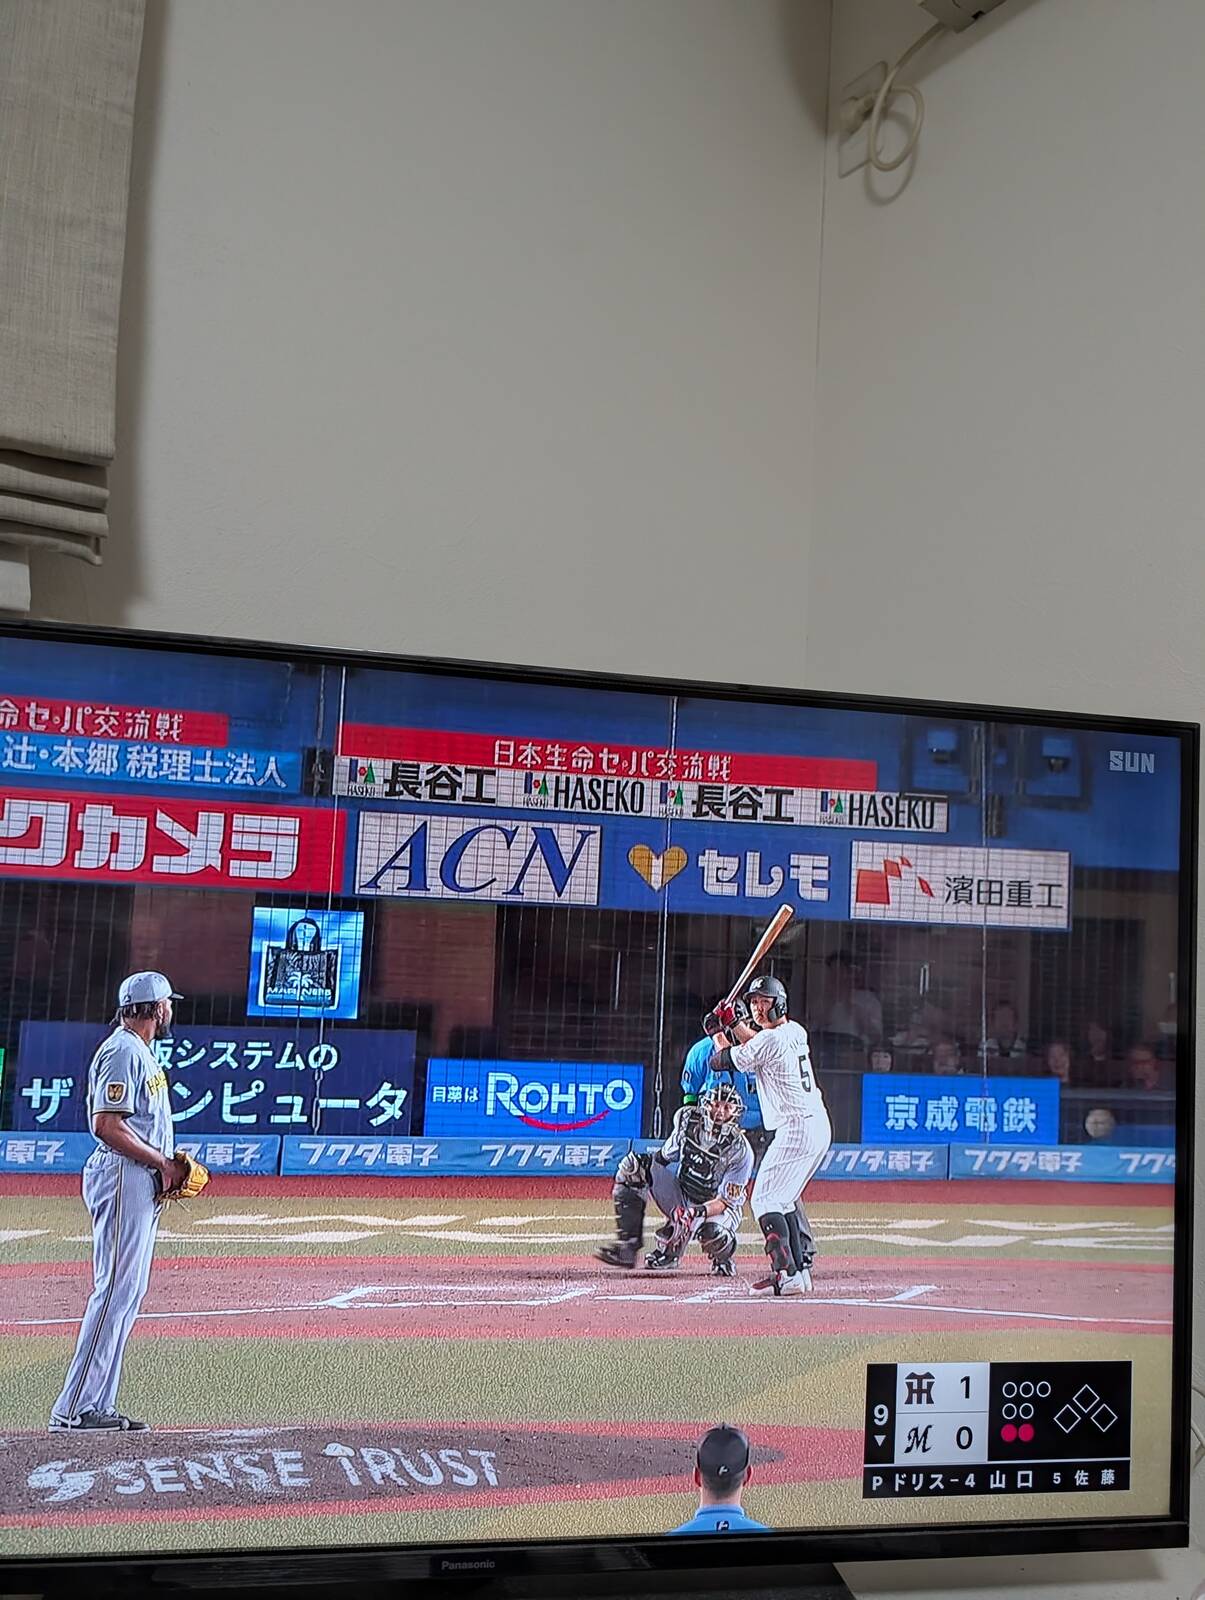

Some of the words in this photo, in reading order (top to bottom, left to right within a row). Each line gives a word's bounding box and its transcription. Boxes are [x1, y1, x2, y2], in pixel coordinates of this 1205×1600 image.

[1109, 750, 1155, 774] SUN
[383, 761, 497, 804] 長谷工
[553, 775, 645, 814] HASEKO
[691, 784, 795, 823] 長谷工
[358, 819, 598, 899] ACN
[697, 849, 831, 902] セレモ
[944, 876, 1064, 909] 濱田重工
[799, 1055, 811, 1092] 5
[21, 1077, 74, 1123] ザ
[884, 1095, 1037, 1134] 京成電鉄
[301, 1143, 440, 1168] フクダ電子
[481, 1144, 614, 1168] フクダ電子
[964, 1150, 1083, 1174] フクダ電子
[960, 1376, 971, 1399] 1
[873, 1405, 889, 1426] 9
[956, 1427, 973, 1450] 0
[113, 1448, 313, 1494] SENSE
[322, 1442, 502, 1487] TRUST
[872, 1476, 883, 1491] P
[1052, 1472, 1062, 1485] 5
[441, 1560, 496, 1570] Panasonic
